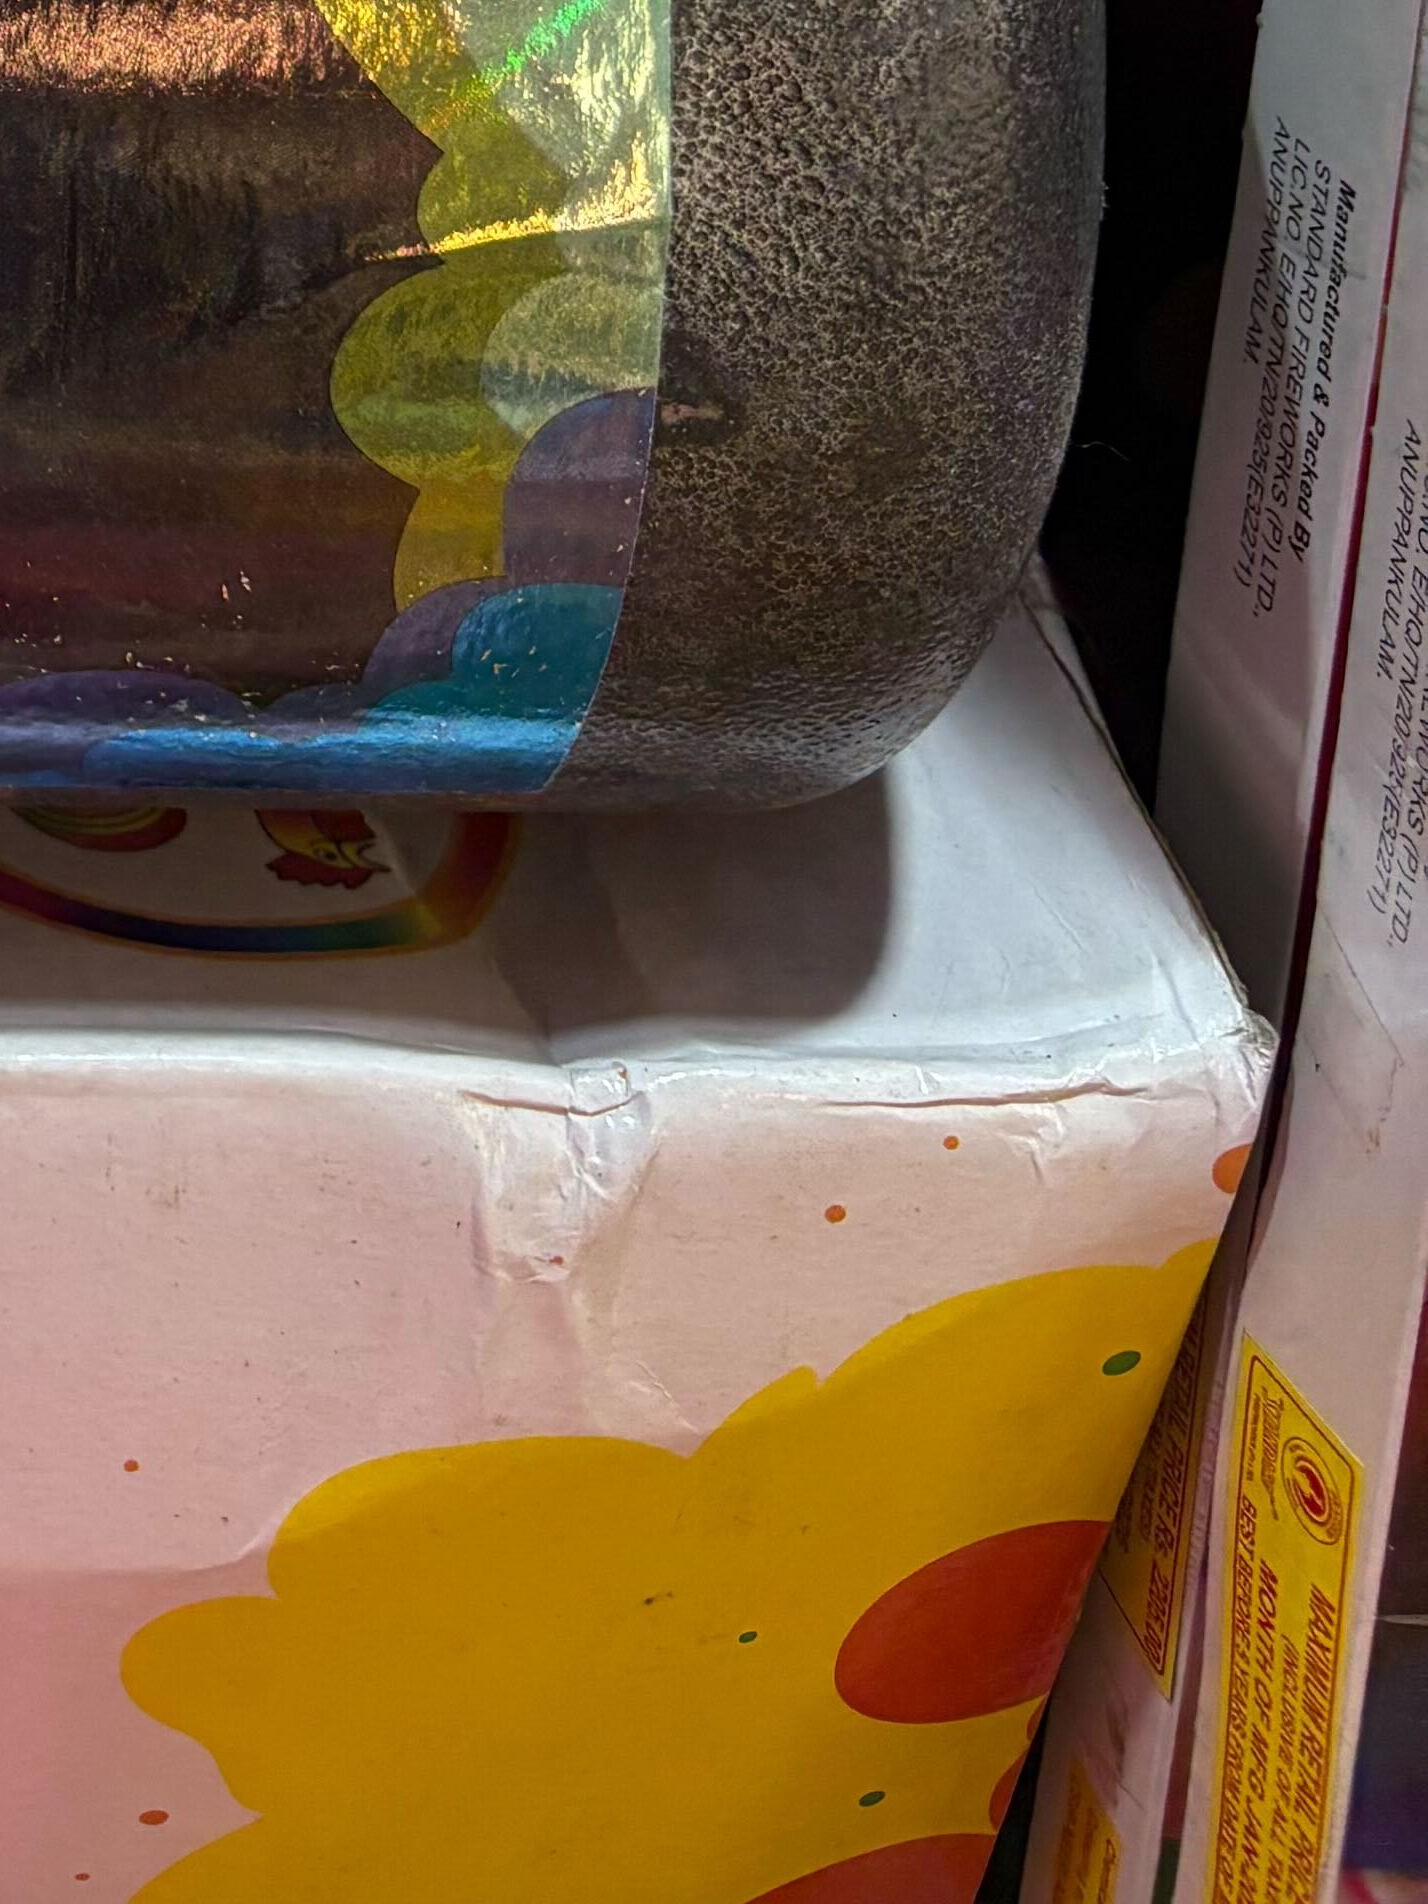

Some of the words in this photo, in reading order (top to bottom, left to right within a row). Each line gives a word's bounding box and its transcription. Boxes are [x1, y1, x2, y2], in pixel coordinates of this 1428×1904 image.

[1240, 115, 1294, 364] ANUPPANKULAM.
[1292, 160, 1335, 324] STANDARD
[1311, 178, 1358, 381] Manufactured
[1267, 326, 1312, 505] FIREWORKS
[1312, 382, 1331, 407] &
[1295, 411, 1326, 520] Packed
[1259, 507, 1284, 553] (P)
[1284, 520, 1309, 565] By
[1373, 419, 1424, 680] ANUPPANKULAM.
[1158, 1431, 1185, 1535] PRICE
[1237, 1488, 1258, 1566] BEST
[1232, 1549, 1257, 1653] BEFORE
[1251, 1552, 1282, 1685] MONTH
[1251, 1668, 1273, 1735] OF
[1299, 1573, 1337, 1742] MAXIMUM
[1245, 1717, 1269, 1808] MFG
[1293, 1715, 1324, 1841] RETAIL
